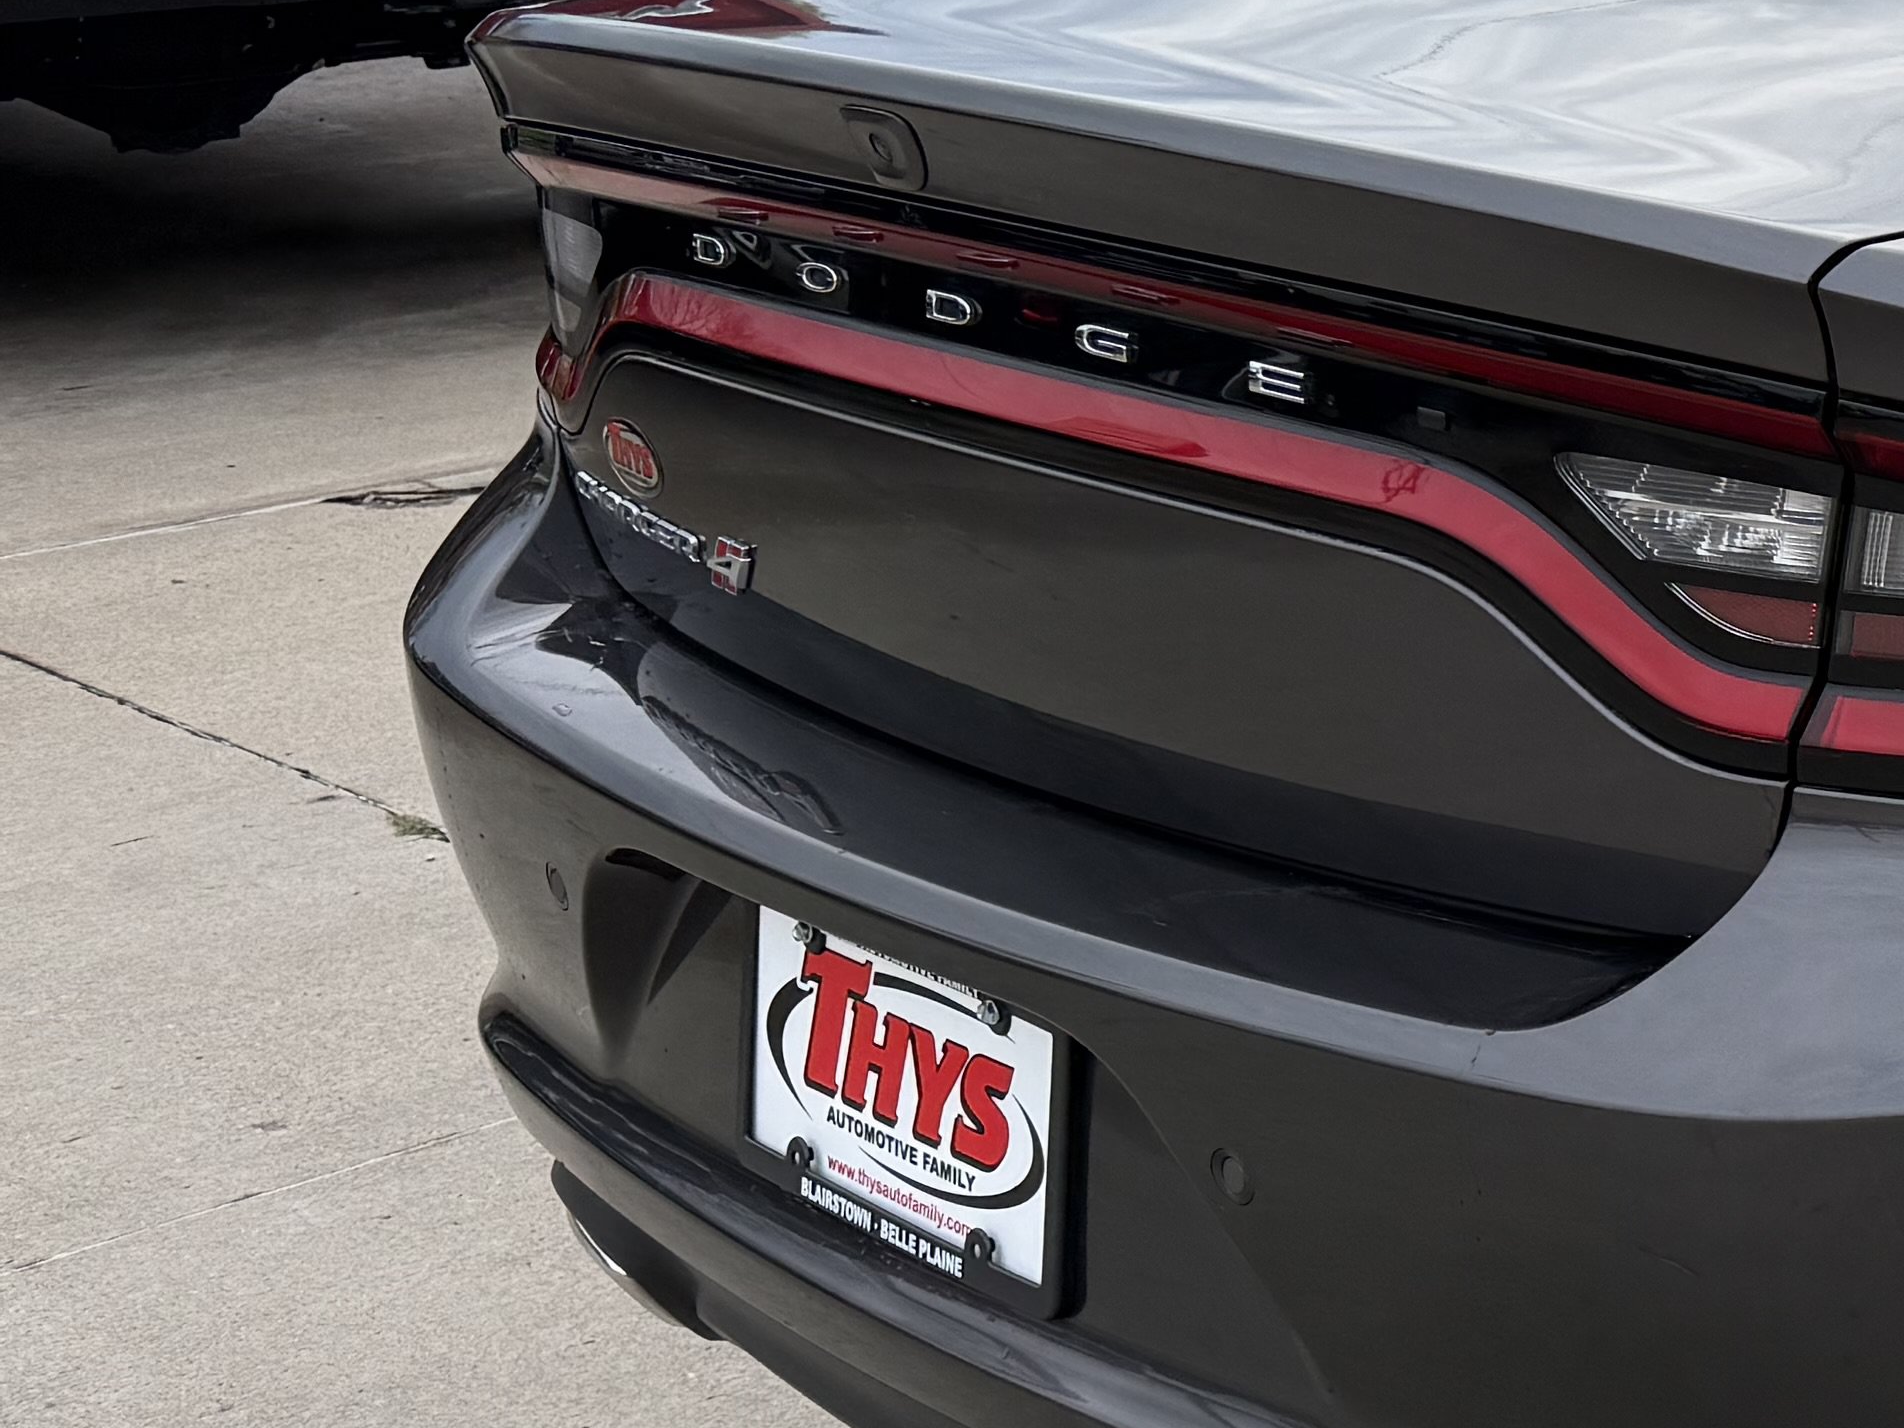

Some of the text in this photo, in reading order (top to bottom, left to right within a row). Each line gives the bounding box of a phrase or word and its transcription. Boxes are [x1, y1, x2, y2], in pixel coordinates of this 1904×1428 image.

[691, 232, 1310, 405] DODGE
[801, 947, 1015, 1172] THYS
[827, 1106, 976, 1192] AUTOMOTIVE FAMILY
[801, 1177, 963, 1278] BLAIRSTOWN BELLE PLAINE
